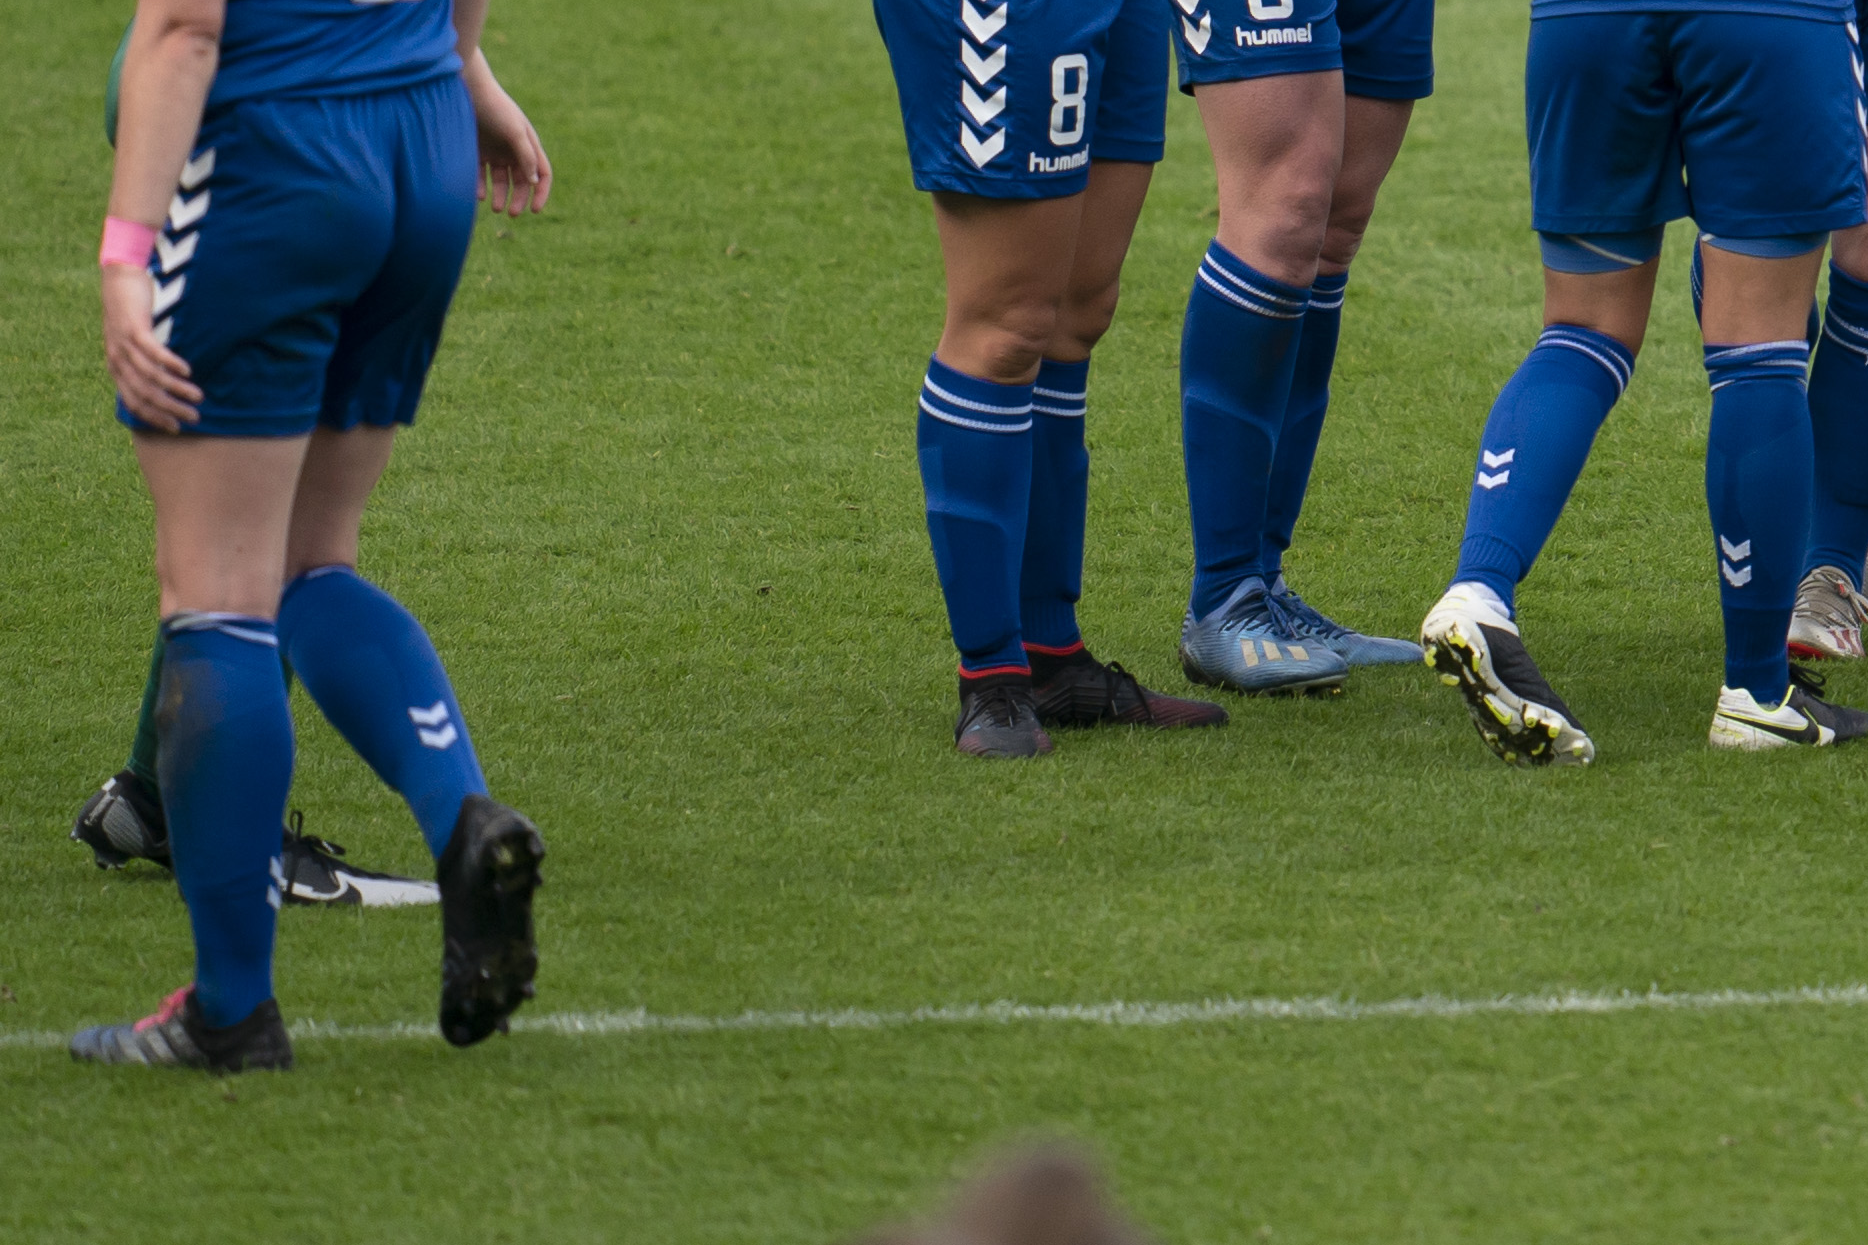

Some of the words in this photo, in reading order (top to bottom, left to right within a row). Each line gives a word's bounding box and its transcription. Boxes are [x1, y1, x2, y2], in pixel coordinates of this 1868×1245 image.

[1235, 22, 1312, 47] hummel
[1049, 53, 1089, 146] 8
[1029, 143, 1090, 173] hummel
